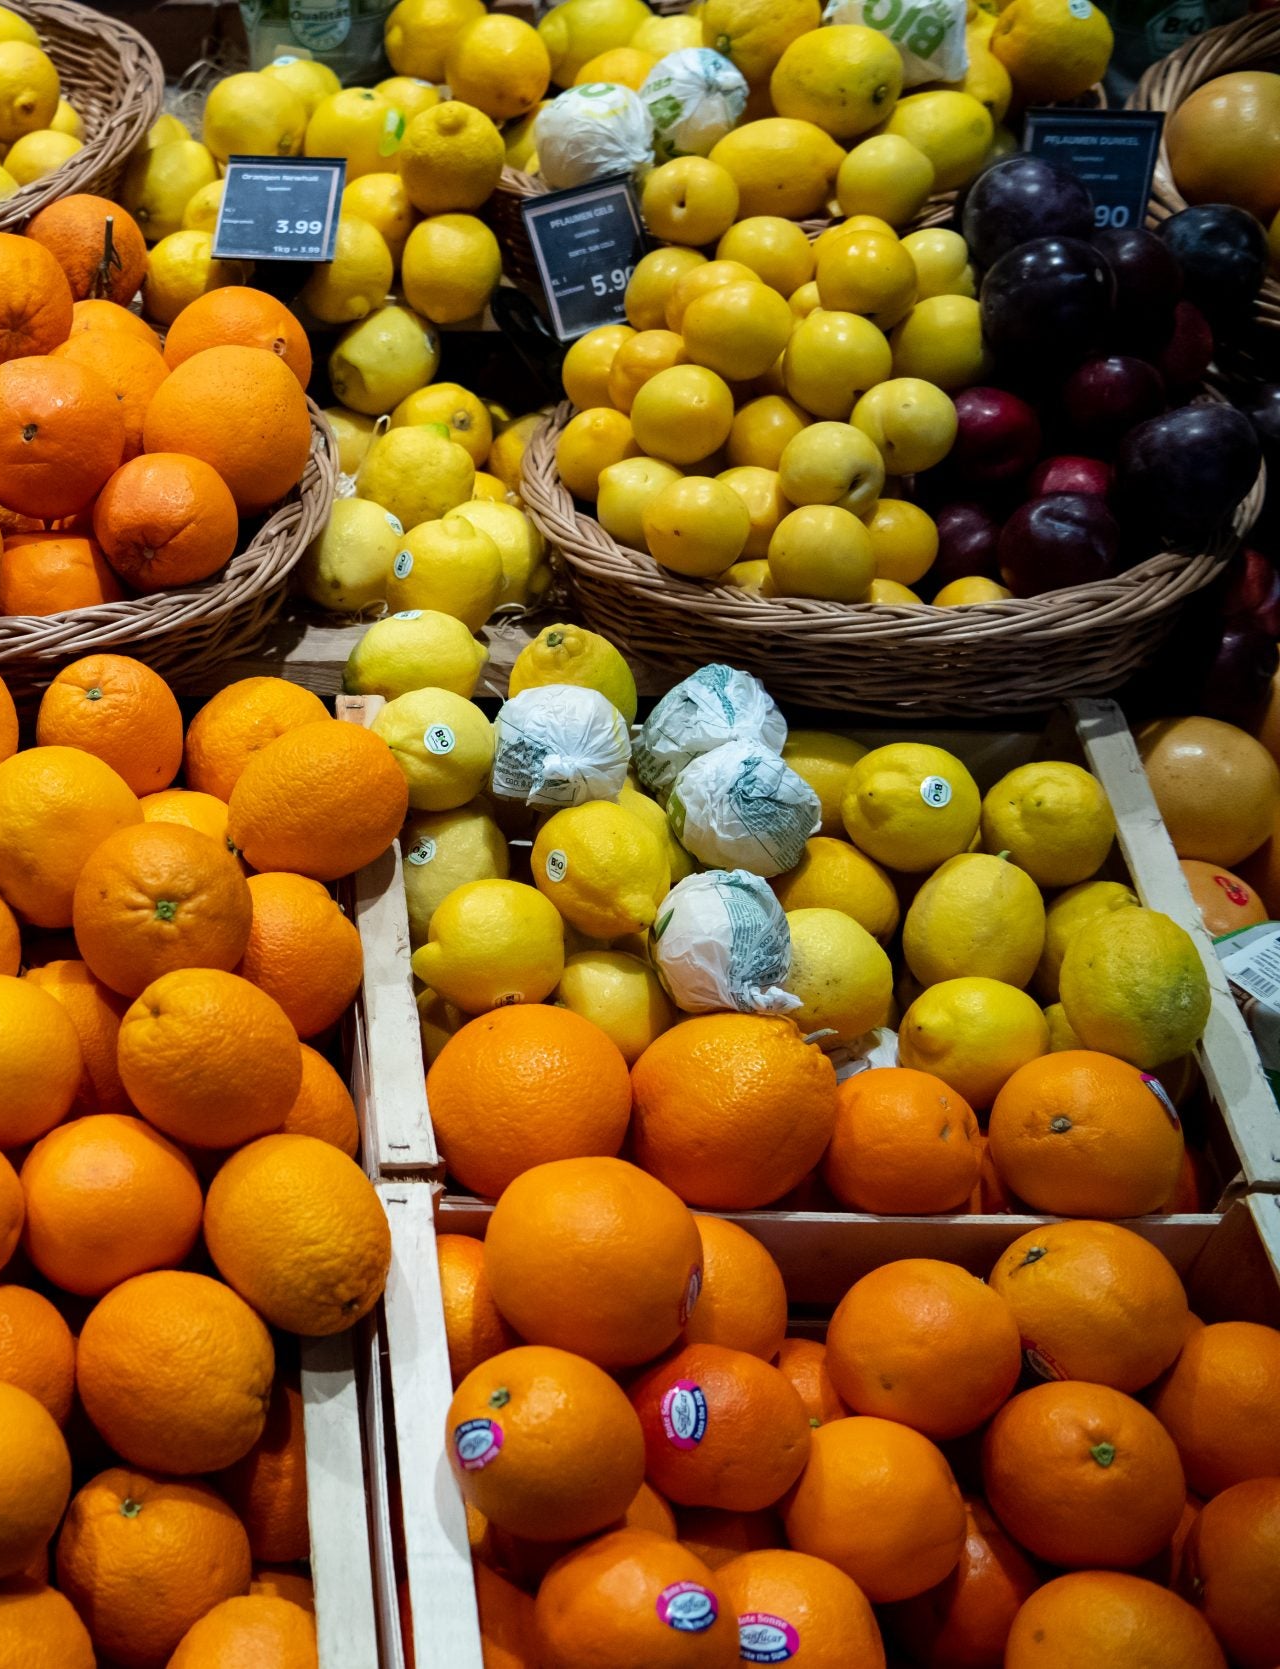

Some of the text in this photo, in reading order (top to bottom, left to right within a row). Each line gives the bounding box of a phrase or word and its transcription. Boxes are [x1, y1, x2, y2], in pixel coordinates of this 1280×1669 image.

[242, 173, 280, 181] Orangen
[276, 219, 322, 235] 3.99
[664, 1417, 675, 1439] Rote
[757, 1613, 789, 1630] Sonne
